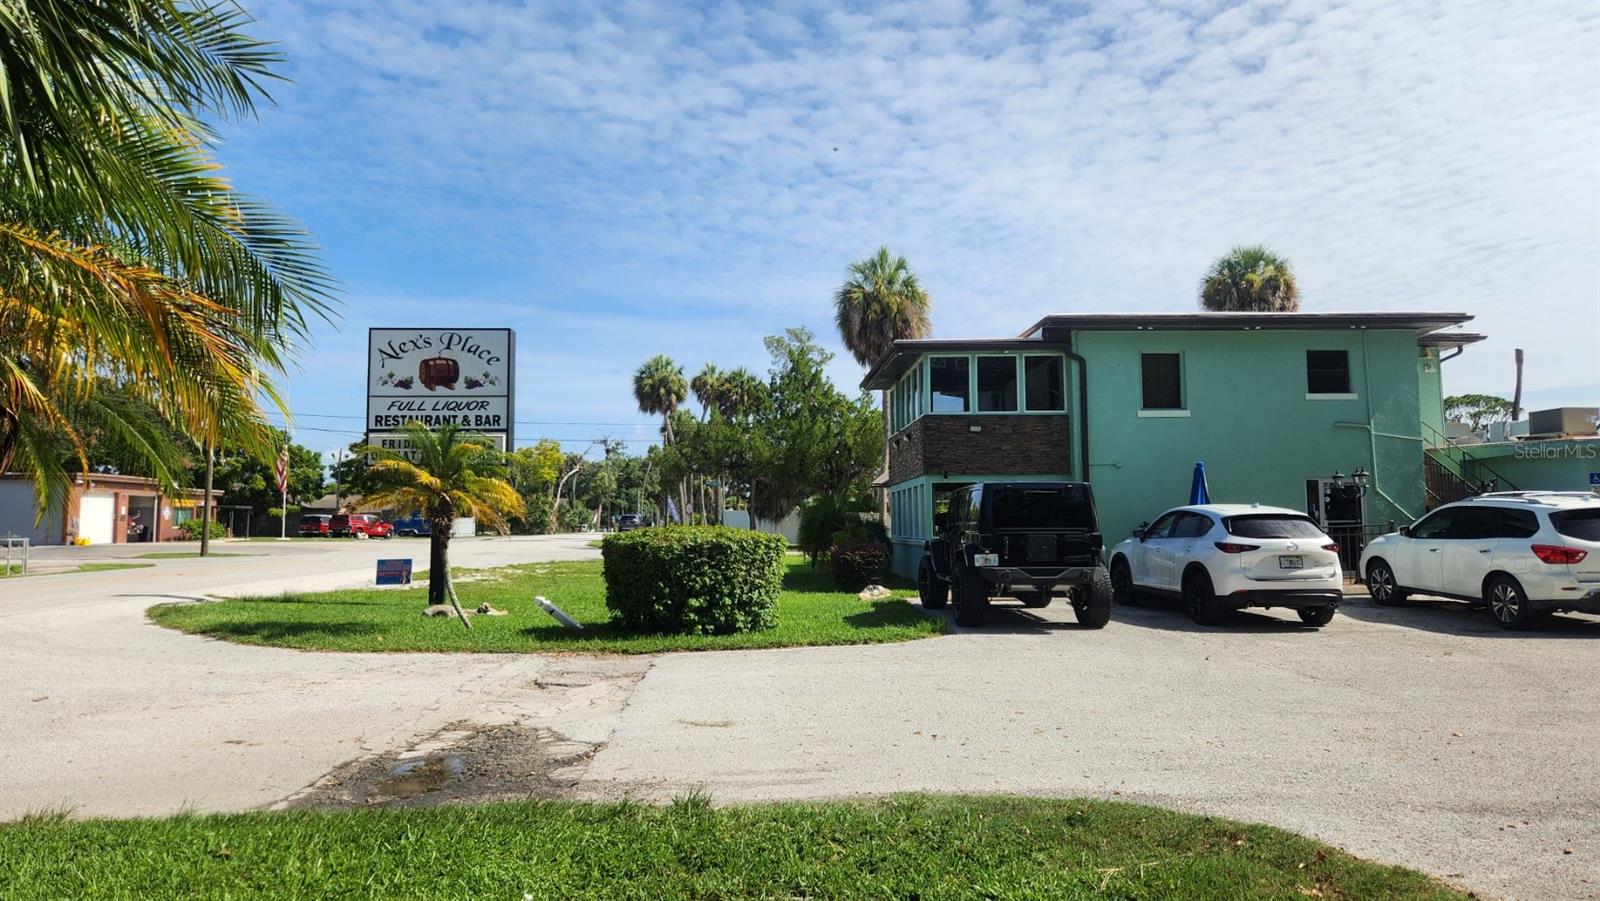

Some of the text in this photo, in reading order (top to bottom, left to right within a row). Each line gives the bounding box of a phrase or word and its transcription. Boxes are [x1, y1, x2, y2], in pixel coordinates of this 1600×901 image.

[377, 332, 500, 368] Alex's Place
[387, 400, 490, 412] FULL LIQUOR
[461, 415, 471, 427] &
[475, 415, 501, 427] BAR
